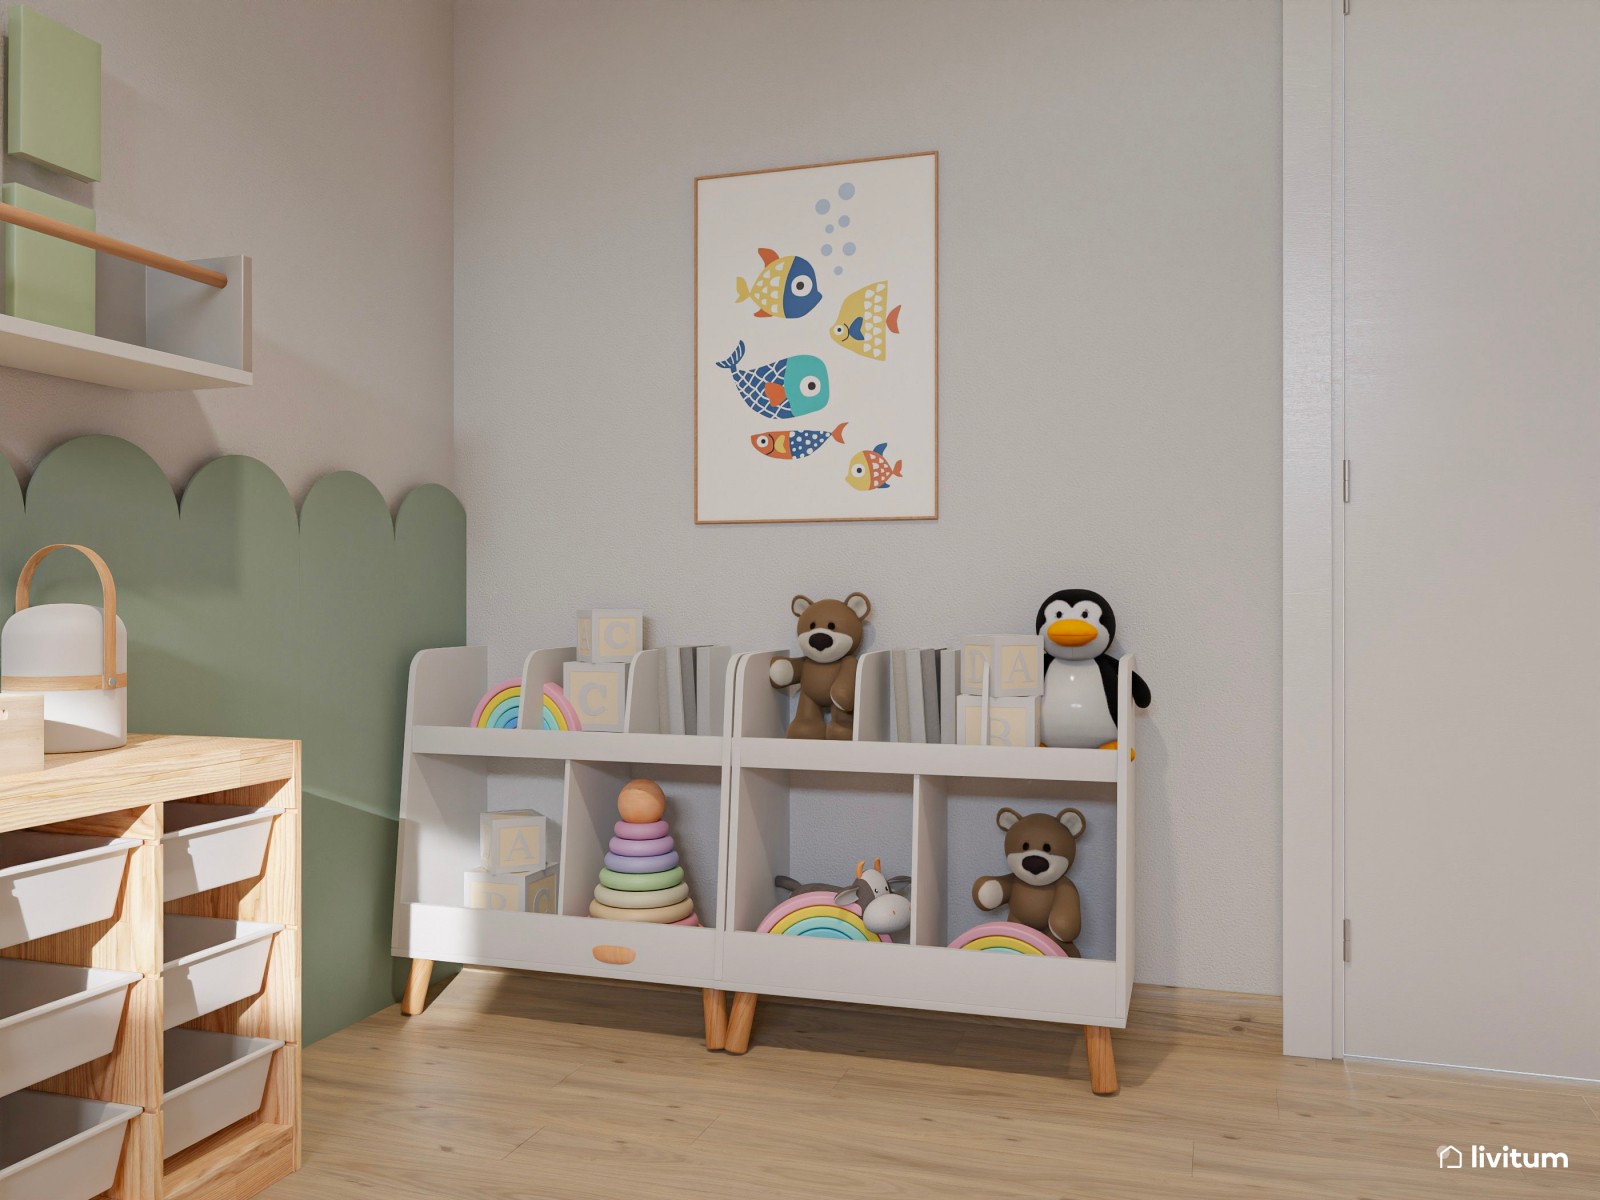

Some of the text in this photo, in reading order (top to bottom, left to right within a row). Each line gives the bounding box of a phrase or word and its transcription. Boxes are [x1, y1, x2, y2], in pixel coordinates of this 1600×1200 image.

[604, 621, 630, 650] C
[1007, 650, 1035, 684] A
[578, 682, 607, 716] C
[504, 831, 535, 861] A
